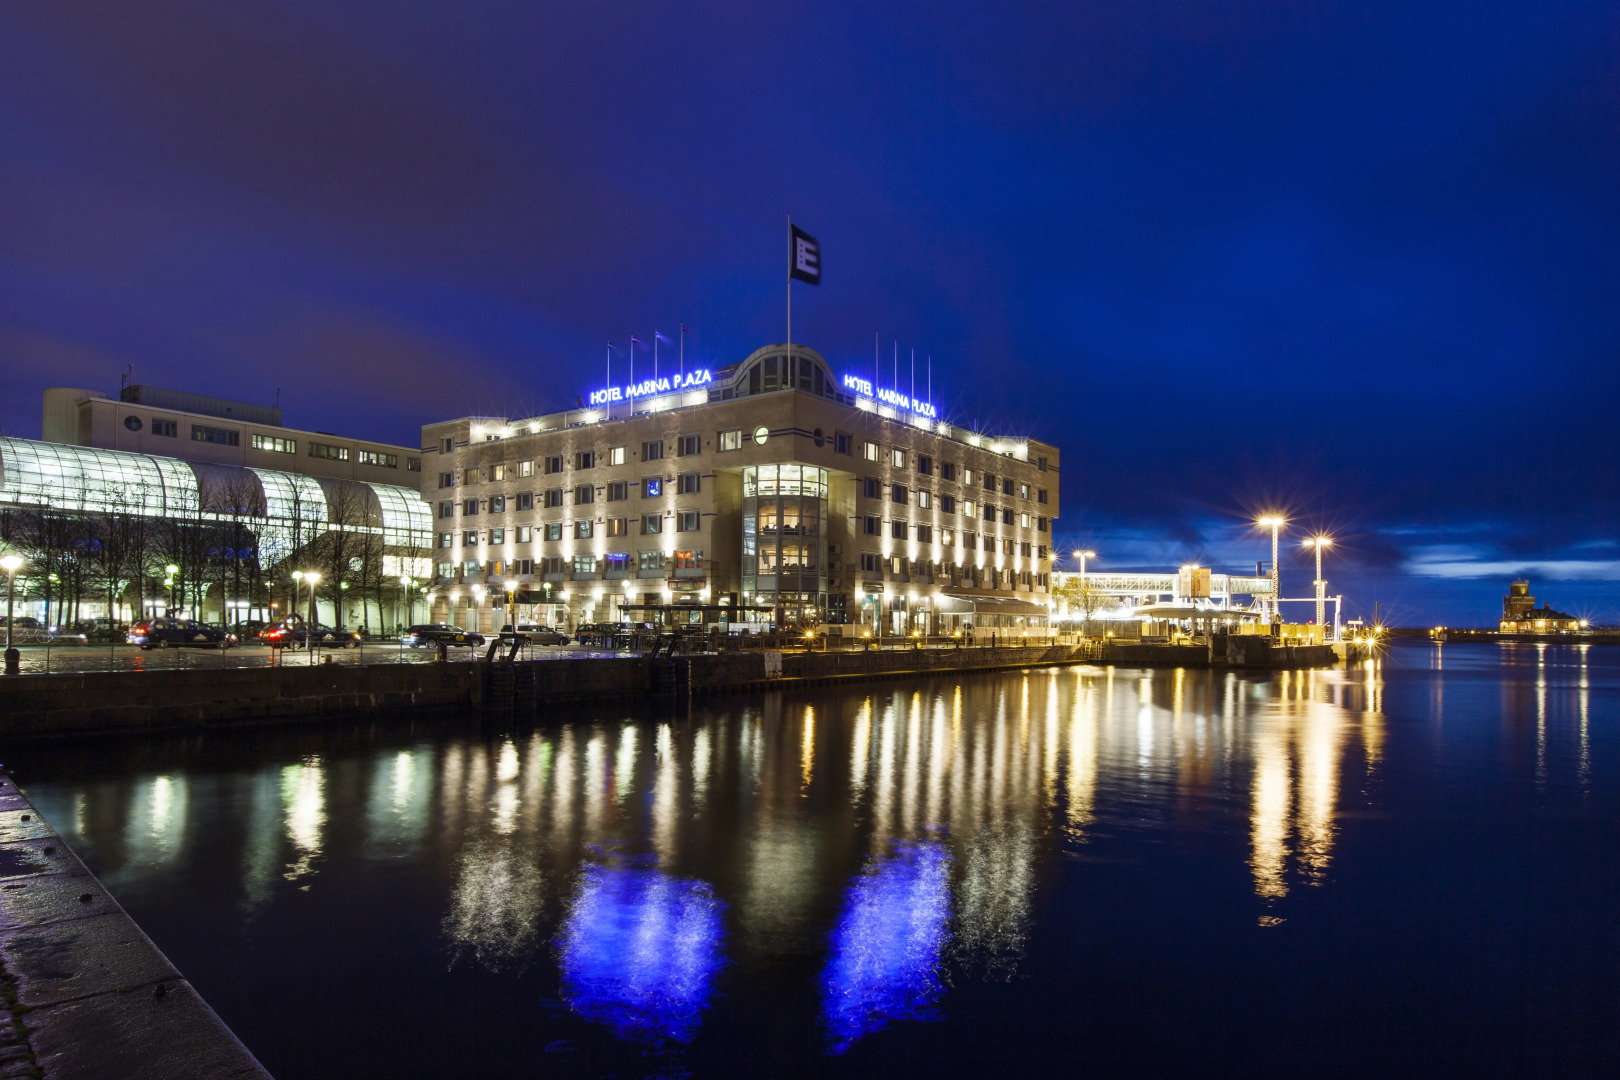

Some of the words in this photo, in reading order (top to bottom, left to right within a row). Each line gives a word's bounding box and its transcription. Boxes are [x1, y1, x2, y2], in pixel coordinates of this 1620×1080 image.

[591, 387, 623, 404] HOTEL
[626, 378, 670, 398] MARINA
[674, 369, 712, 389] PLAZA
[844, 374, 873, 395] HOTEL
[876, 388, 909, 408] MARINA
[912, 398, 936, 418] PLAZA
